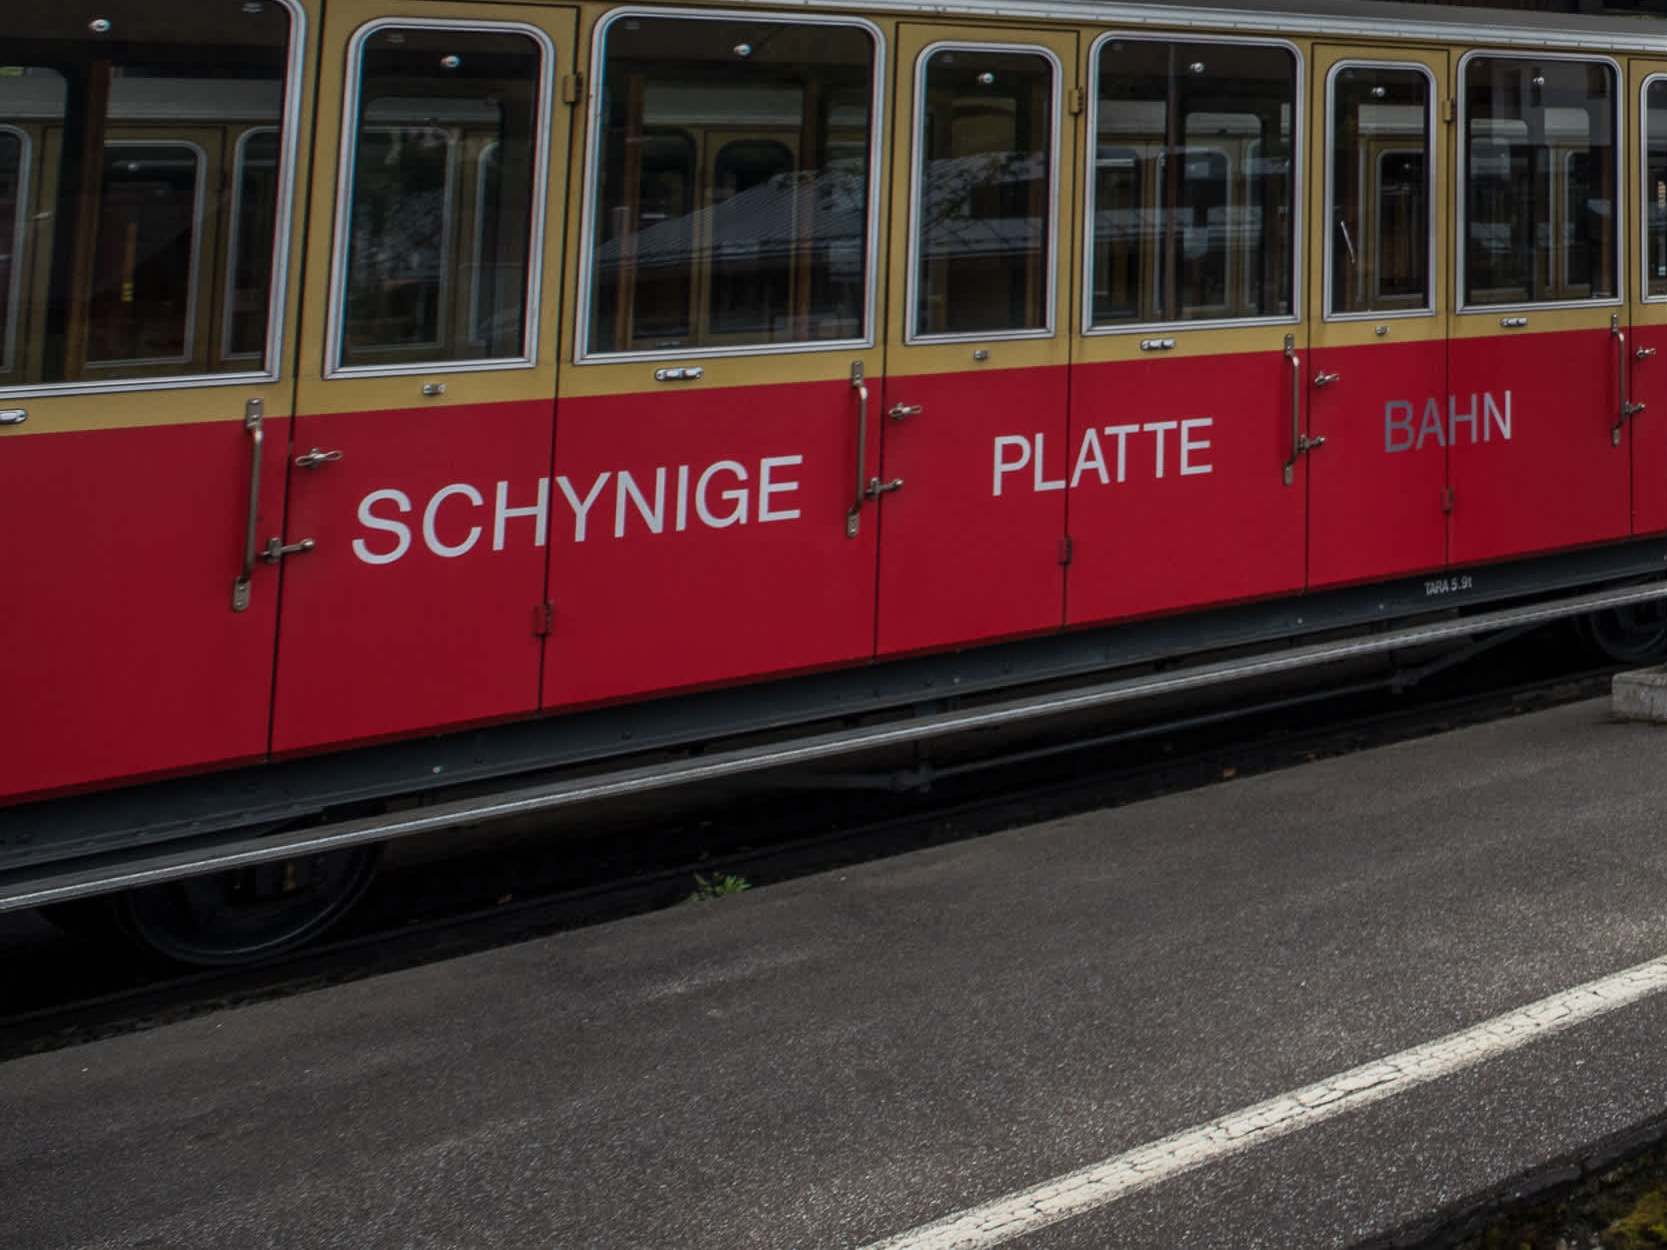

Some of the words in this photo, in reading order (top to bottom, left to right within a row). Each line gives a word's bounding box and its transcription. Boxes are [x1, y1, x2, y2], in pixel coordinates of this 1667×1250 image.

[352, 454, 803, 565] SCHYNIGE
[992, 417, 1213, 497] PLATTE
[1384, 389, 1513, 453] BAHN
[1424, 579, 1449, 595] TARA
